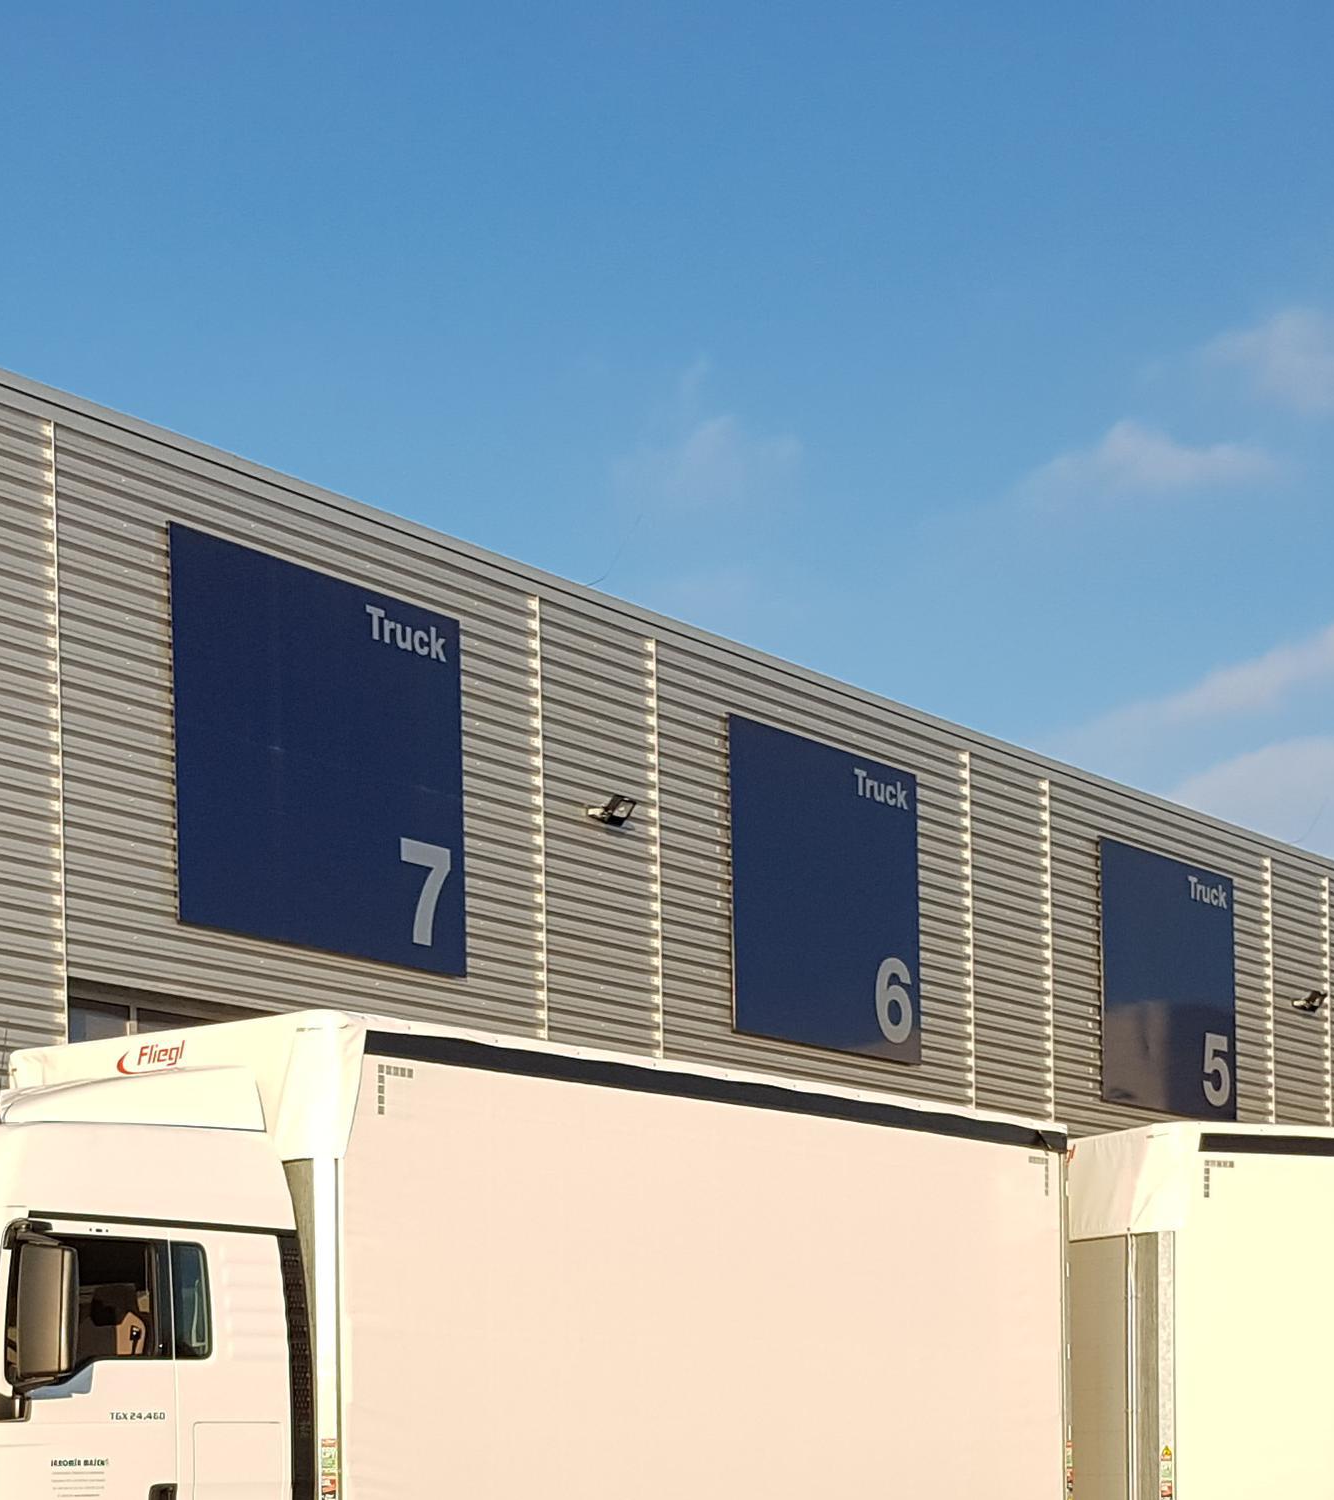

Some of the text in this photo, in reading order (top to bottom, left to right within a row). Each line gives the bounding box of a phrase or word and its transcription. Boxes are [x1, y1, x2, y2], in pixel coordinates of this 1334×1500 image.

[366, 604, 446, 662] Truck
[854, 767, 908, 810] Truck
[400, 837, 451, 946] 7
[1188, 876, 1227, 909] Truck
[875, 957, 912, 1043] 6
[137, 1040, 186, 1067] Fliegl
[1203, 1032, 1230, 1107] 5
[110, 1412, 128, 1420] TGX
